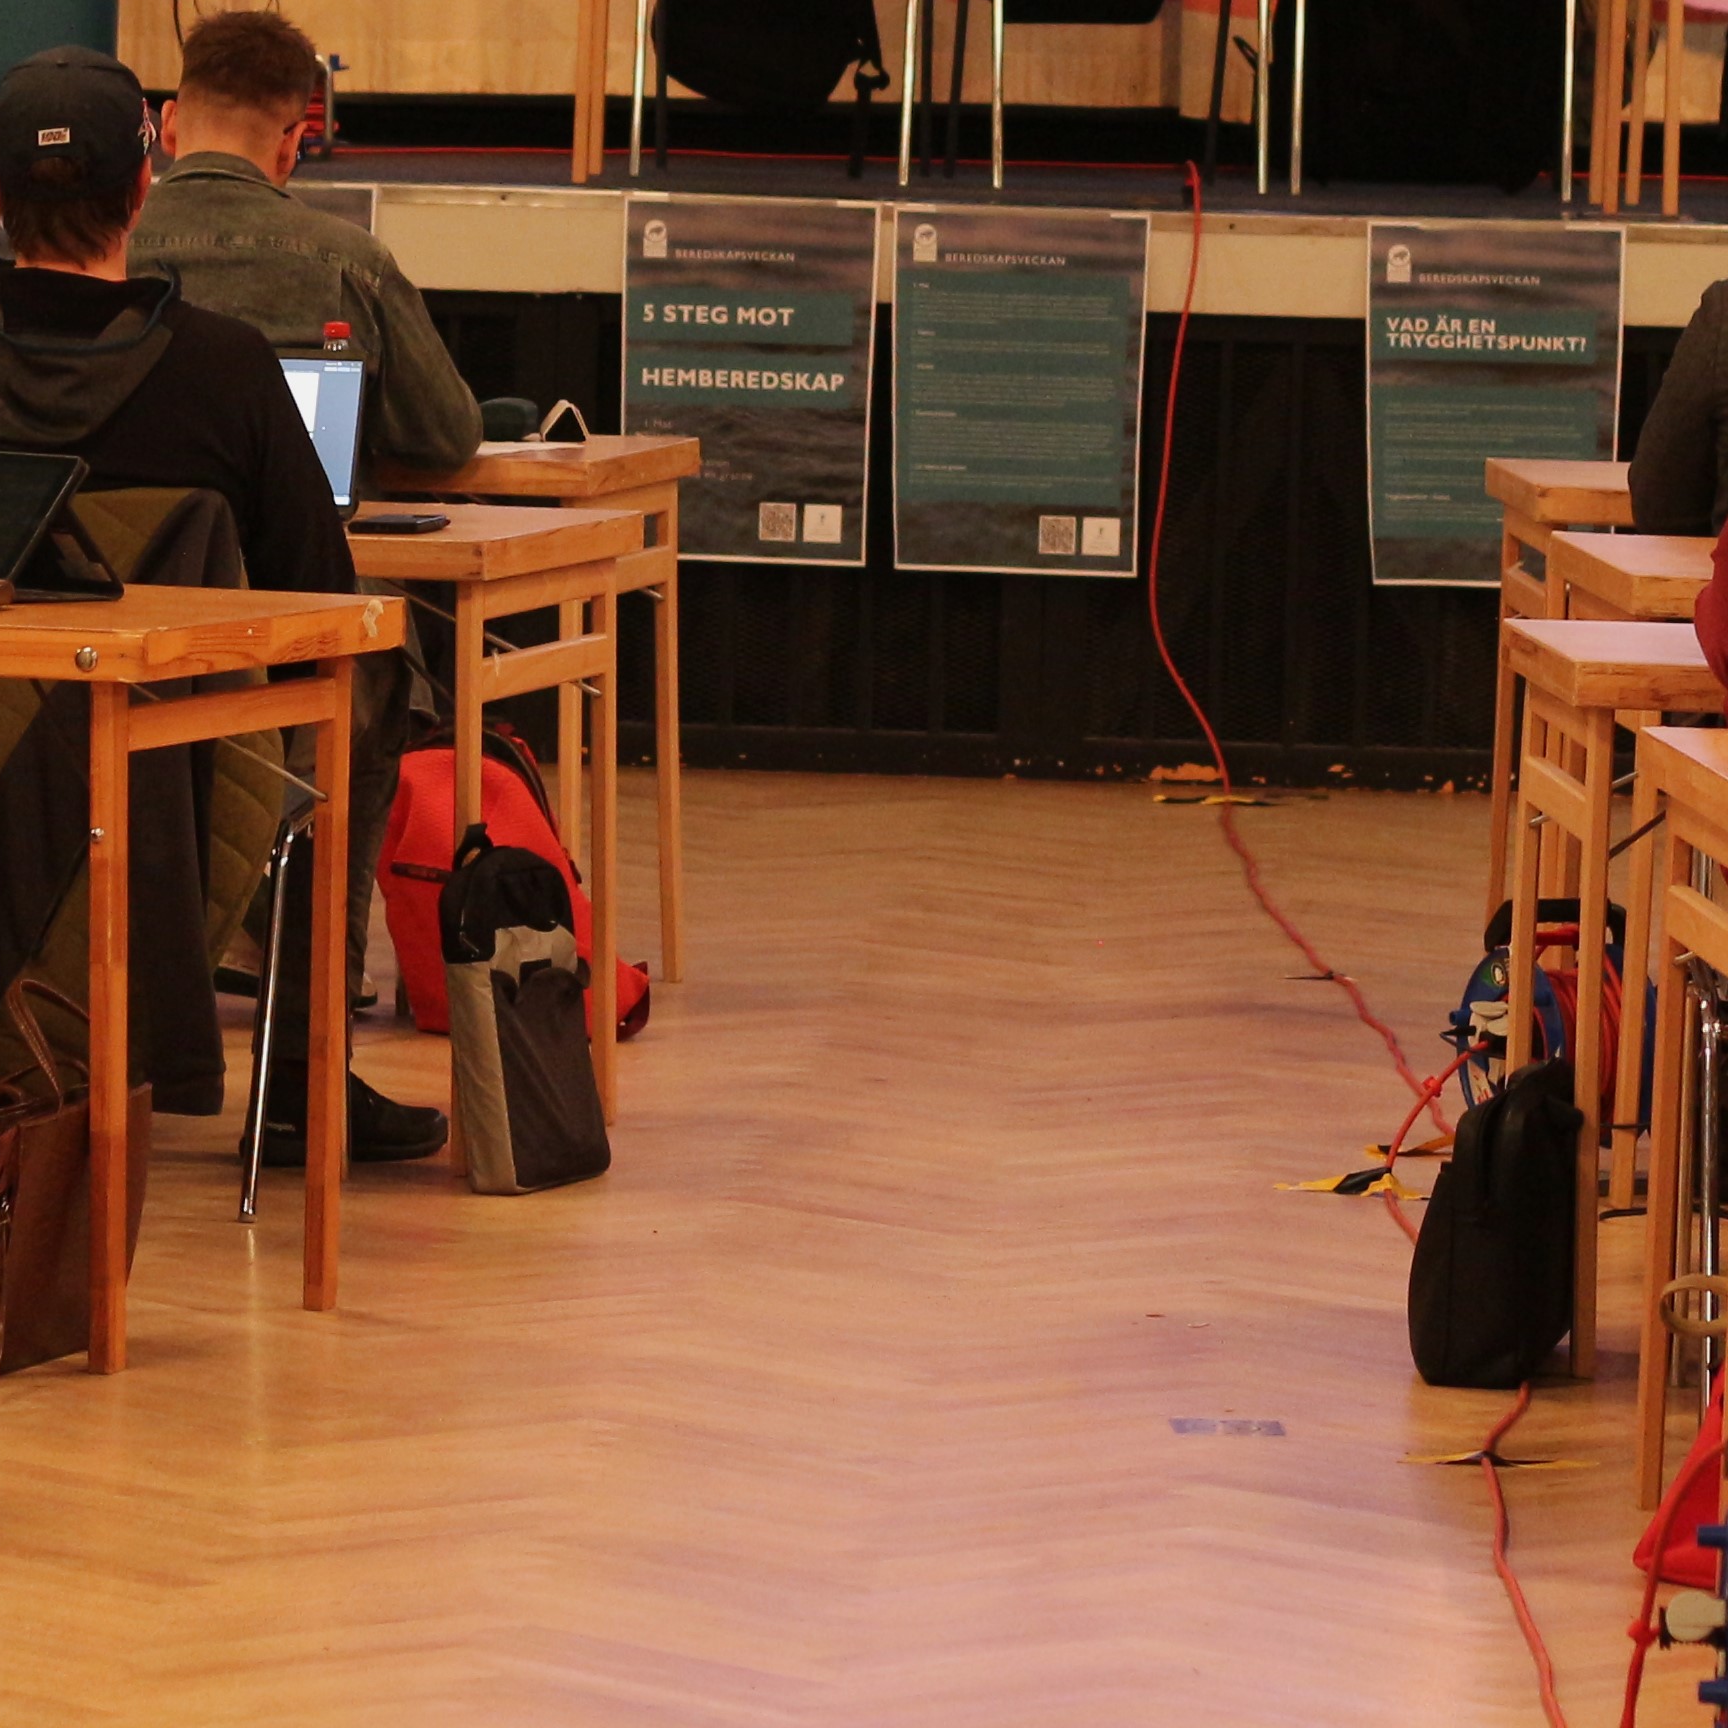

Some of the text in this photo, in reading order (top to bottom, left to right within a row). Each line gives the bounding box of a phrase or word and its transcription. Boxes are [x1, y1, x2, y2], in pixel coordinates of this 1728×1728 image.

[674, 248, 796, 263] BEREDSKAPSVECKAN
[944, 252, 1067, 267] BEREDSKAPSVECKAN
[1418, 273, 1541, 286] BEREDSKAPSVECKAN
[642, 303, 795, 327] 5 STEG MOT
[1386, 314, 1496, 334] VAD ÄR EN
[1386, 332, 1587, 353] TRYGGHETSPUNKT?
[641, 367, 846, 392] HEMBEREDSKAP
